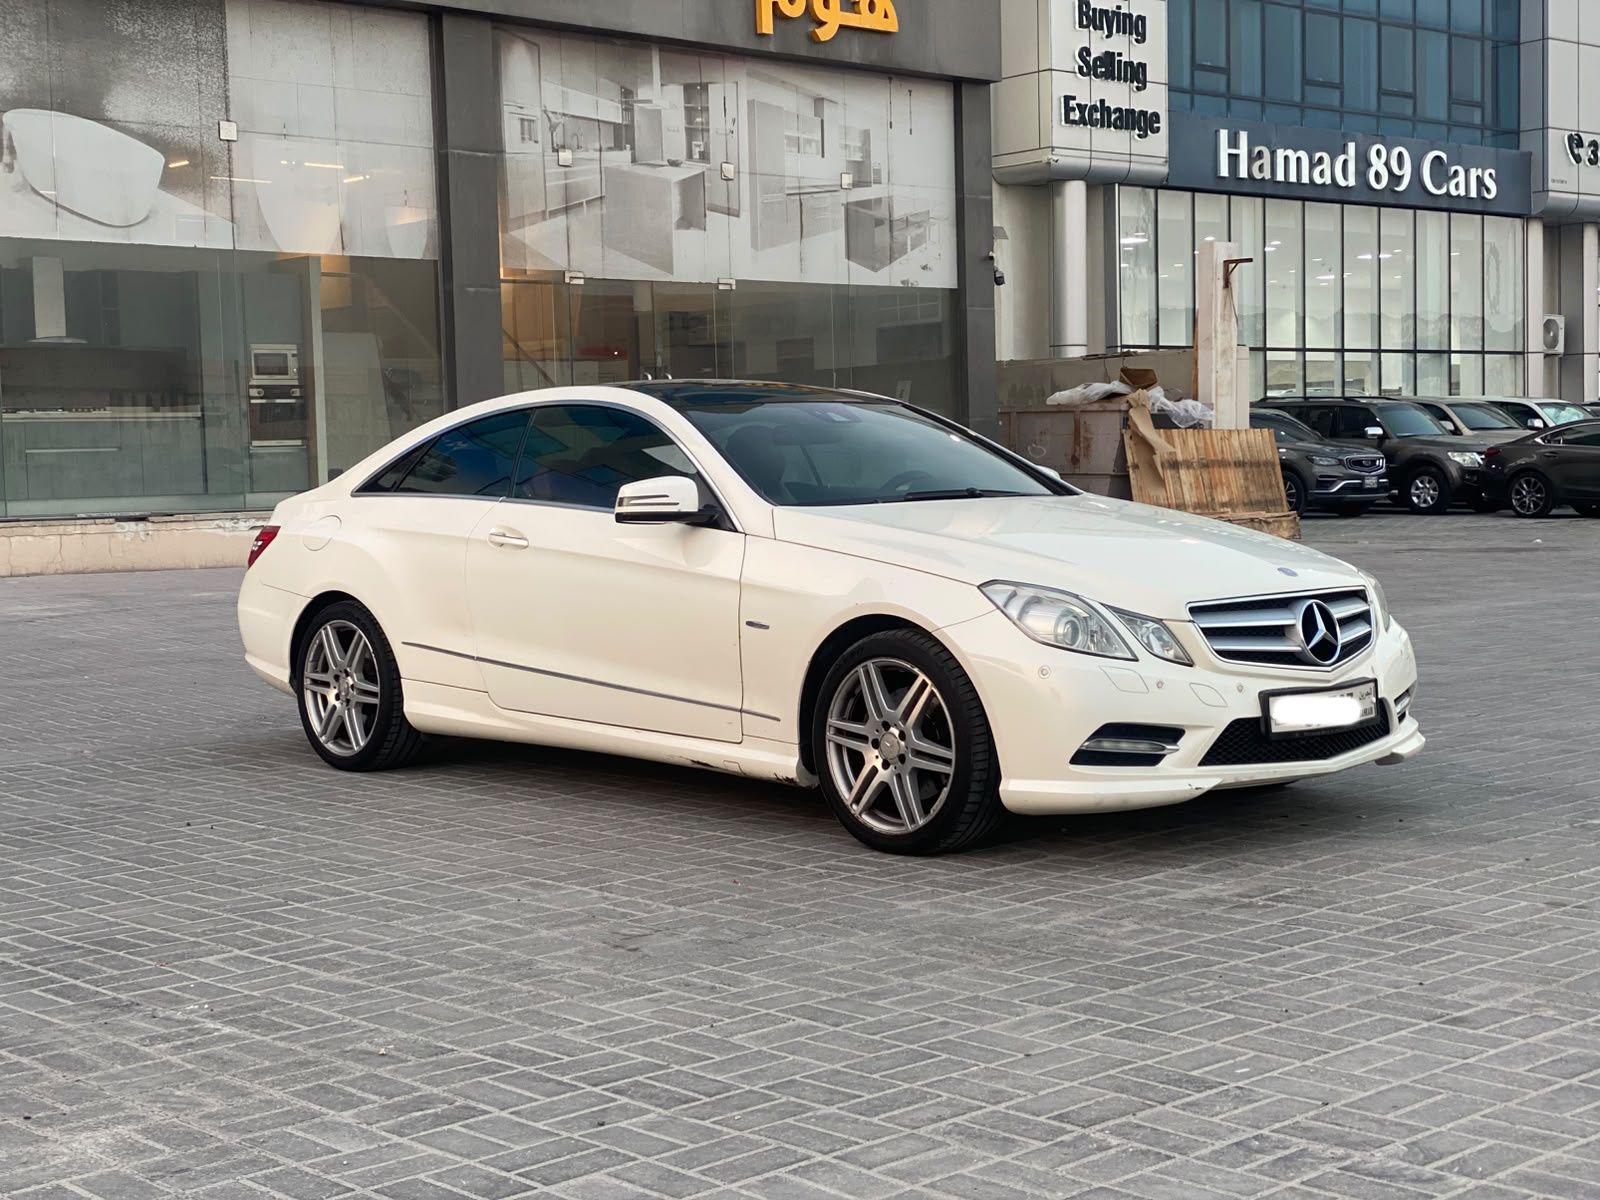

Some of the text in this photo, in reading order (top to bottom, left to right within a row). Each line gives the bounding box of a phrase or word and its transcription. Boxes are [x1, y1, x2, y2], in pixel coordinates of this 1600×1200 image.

[1077, 0, 1147, 44] Buying
[1076, 46, 1147, 91] Selling
[1062, 95, 1161, 139] Exchange
[1217, 129, 1498, 200] Hamad 89 Cars
